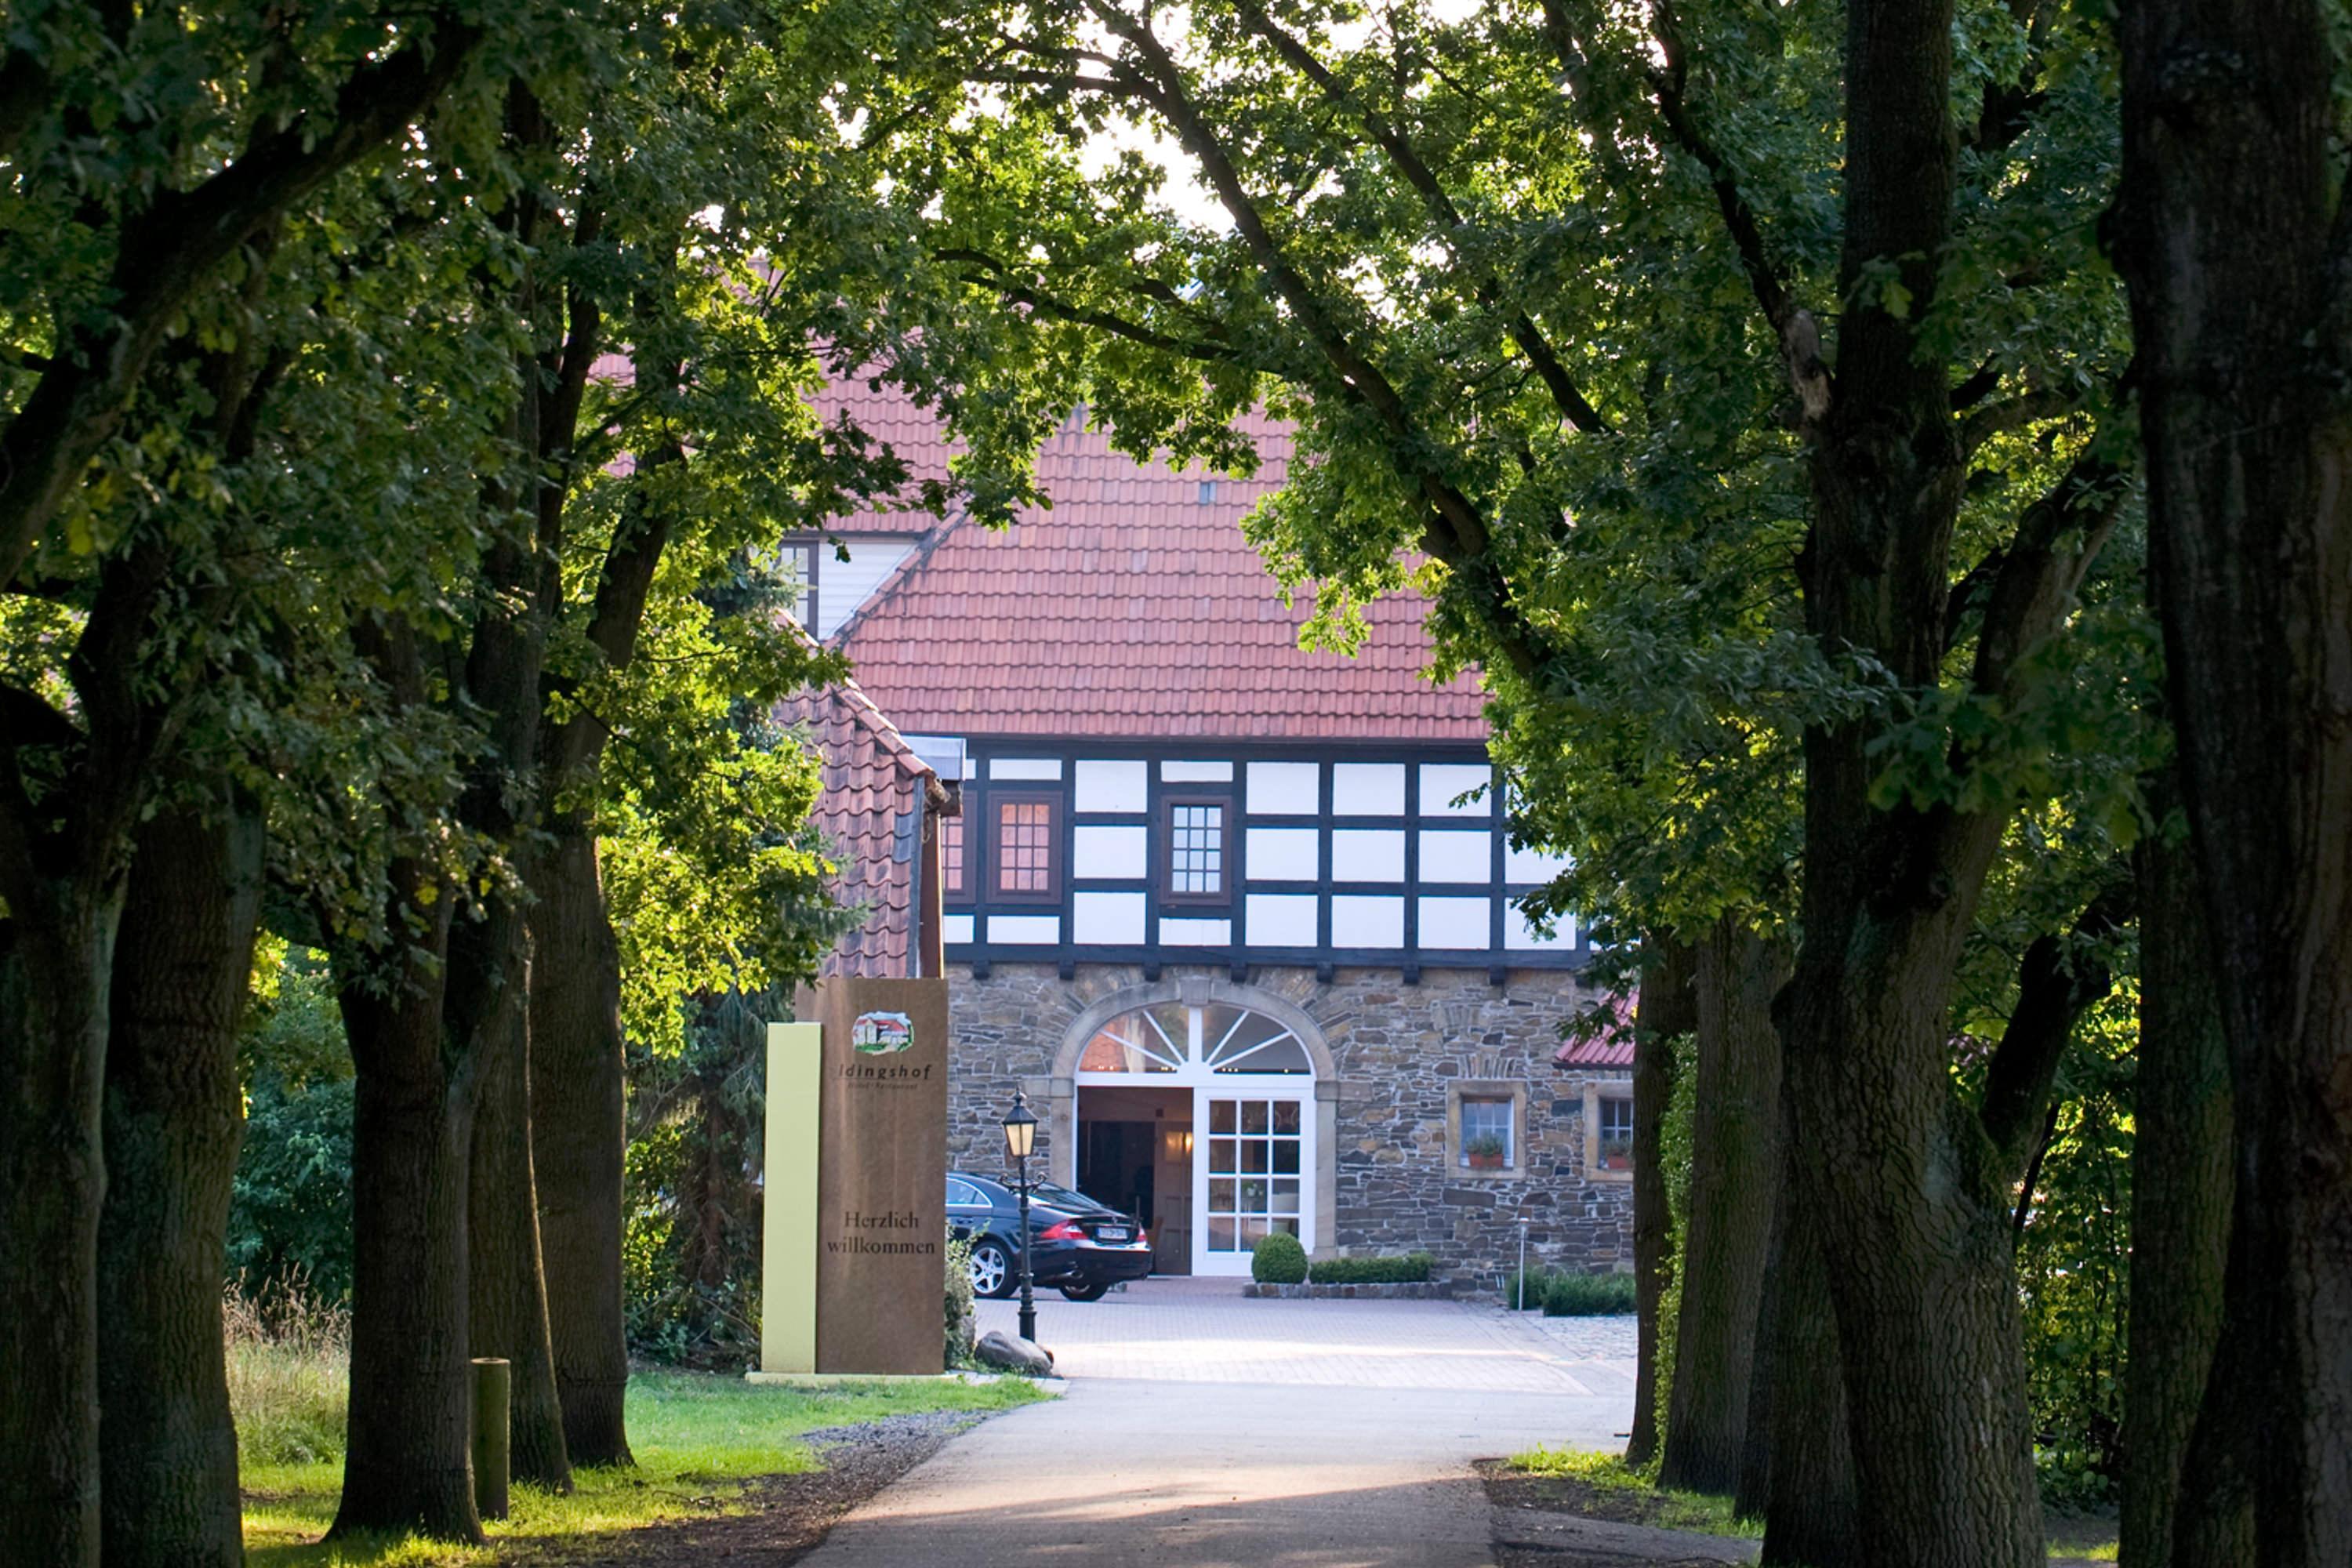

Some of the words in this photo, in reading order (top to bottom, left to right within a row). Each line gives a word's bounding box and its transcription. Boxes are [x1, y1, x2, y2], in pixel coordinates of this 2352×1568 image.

[838, 1063, 932, 1080] Idingshof
[845, 1211, 920, 1229] Herzlich
[827, 1236, 935, 1254] willkommen
